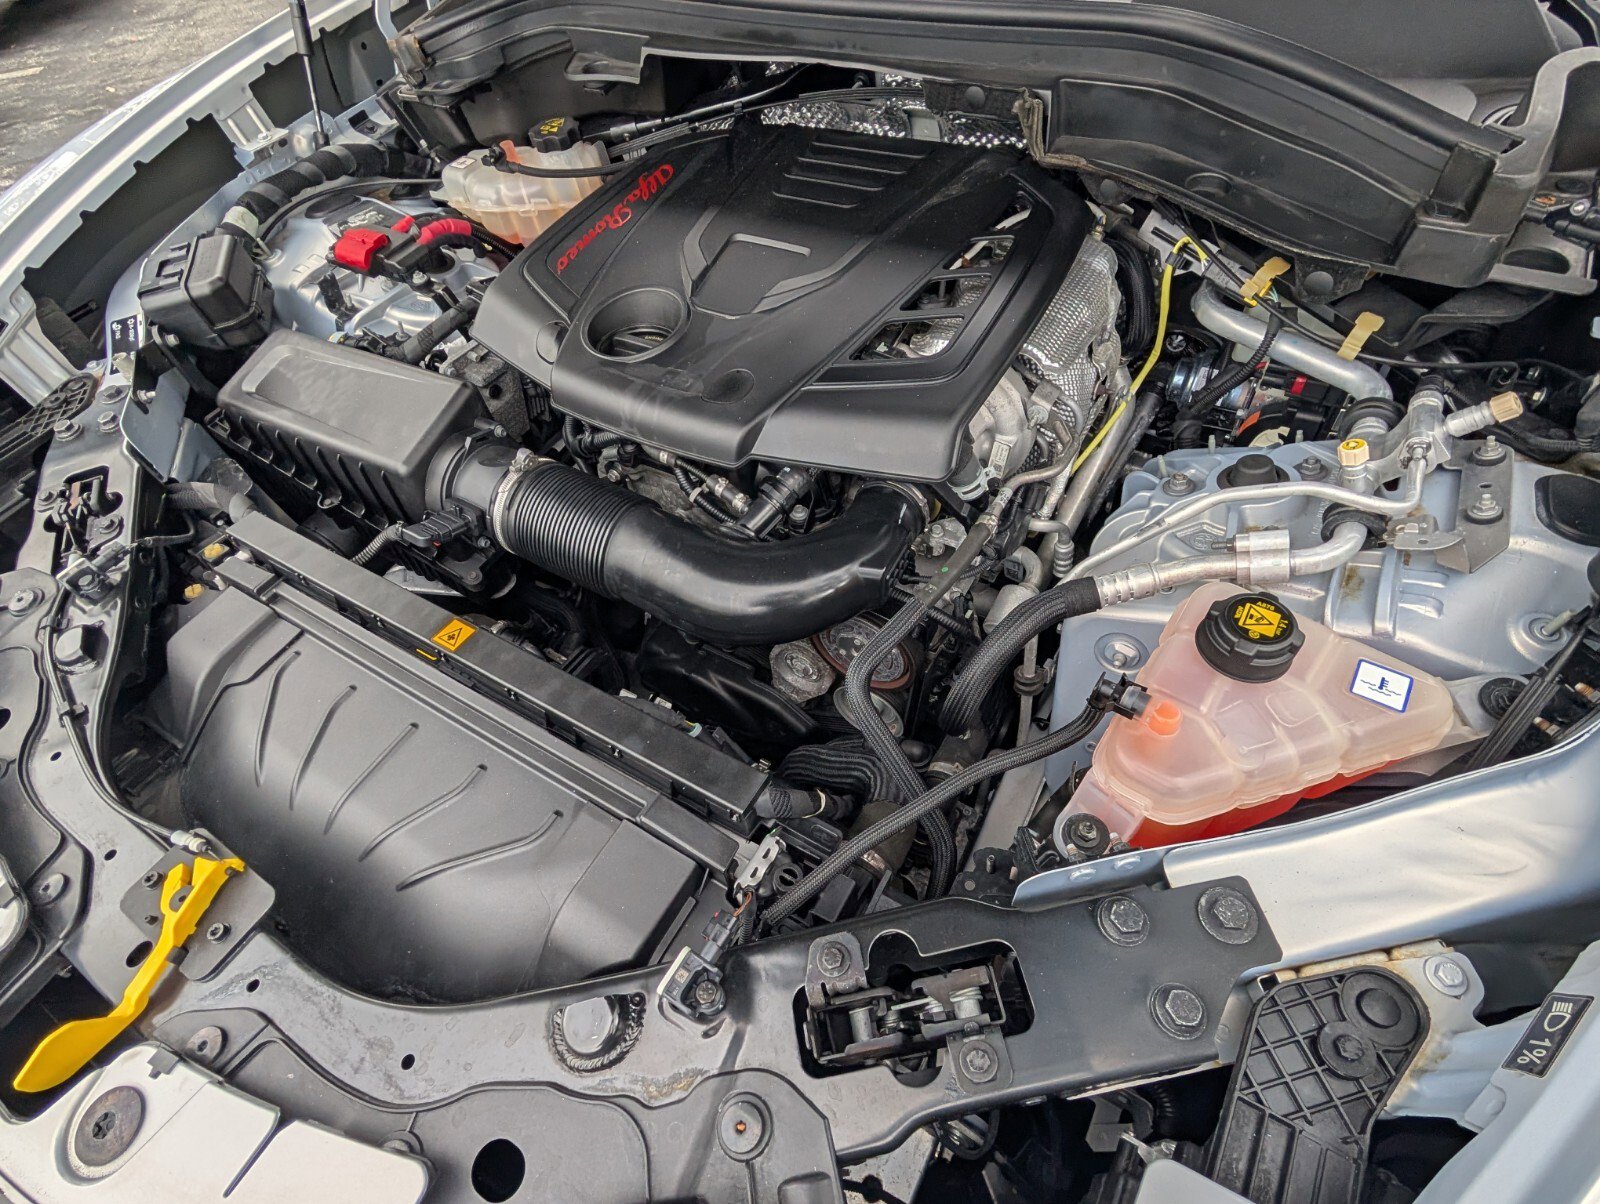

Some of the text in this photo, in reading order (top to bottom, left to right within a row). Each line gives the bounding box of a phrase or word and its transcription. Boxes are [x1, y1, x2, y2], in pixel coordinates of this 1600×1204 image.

[557, 164, 674, 273] Alfa Romeo
[1516, 1038, 1552, 1064] 1%
